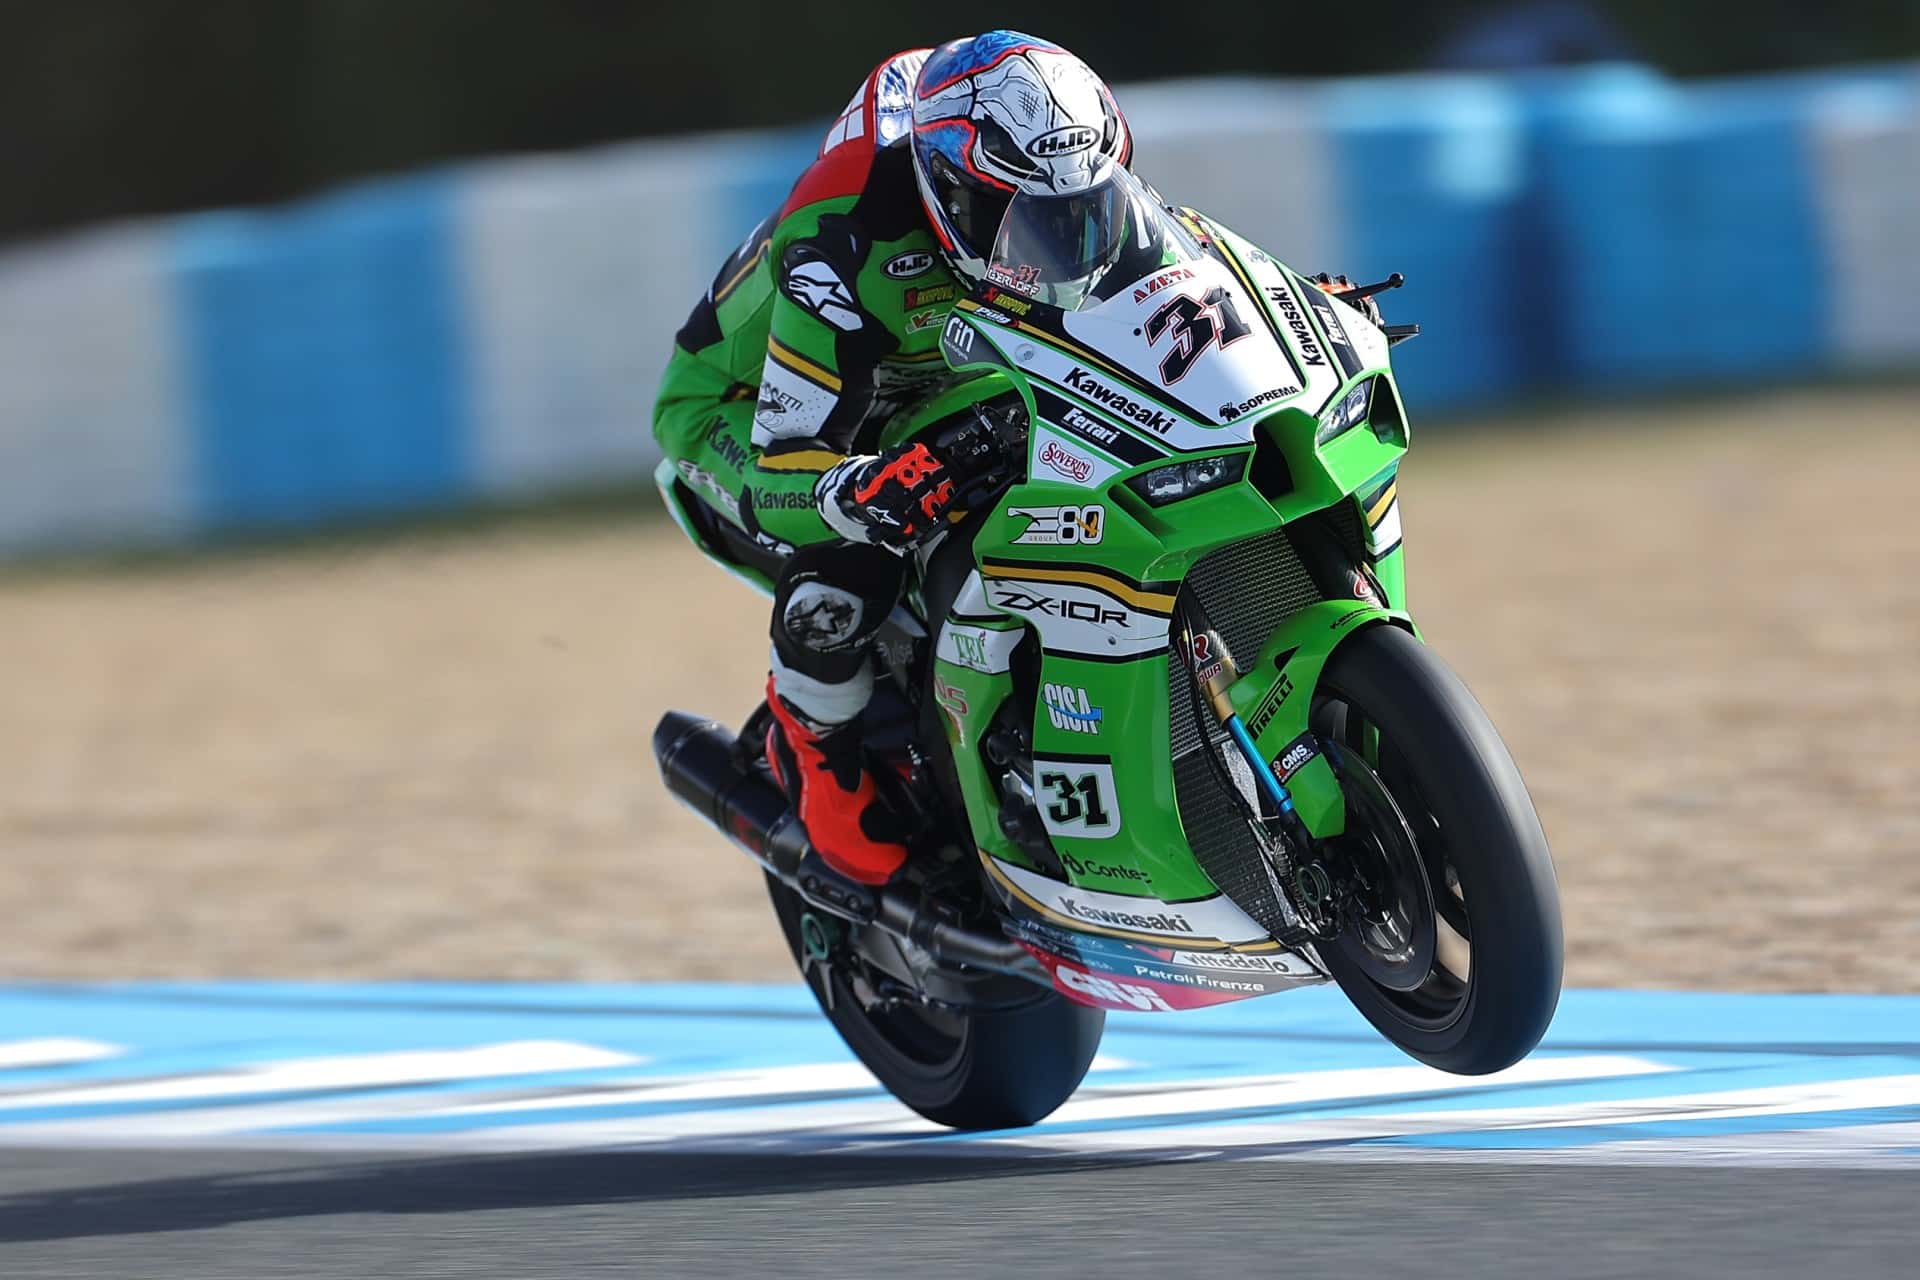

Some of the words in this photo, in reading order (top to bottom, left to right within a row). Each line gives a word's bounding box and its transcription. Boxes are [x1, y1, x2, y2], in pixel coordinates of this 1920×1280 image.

[1038, 130, 1091, 153] HJC
[892, 255, 929, 273] HJC
[988, 269, 1040, 297] GERLOFF
[976, 306, 1012, 324] Puig
[1265, 286, 1326, 367] Kawasaki
[1143, 286, 1252, 387] 31
[1063, 367, 1176, 434] Kawasaki
[1238, 386, 1299, 413] SOPREMA
[1063, 408, 1120, 444] Ferrari
[1042, 442, 1090, 480] SOVERINI
[994, 591, 1131, 627] ZX-10R
[1044, 683, 1098, 735] CISA
[1246, 673, 1294, 741] PIRELLI
[1282, 744, 1307, 769] CMS
[1040, 771, 1111, 828] 31
[1058, 896, 1193, 932] Kawasaki
[1196, 975, 1265, 992] Firenze
